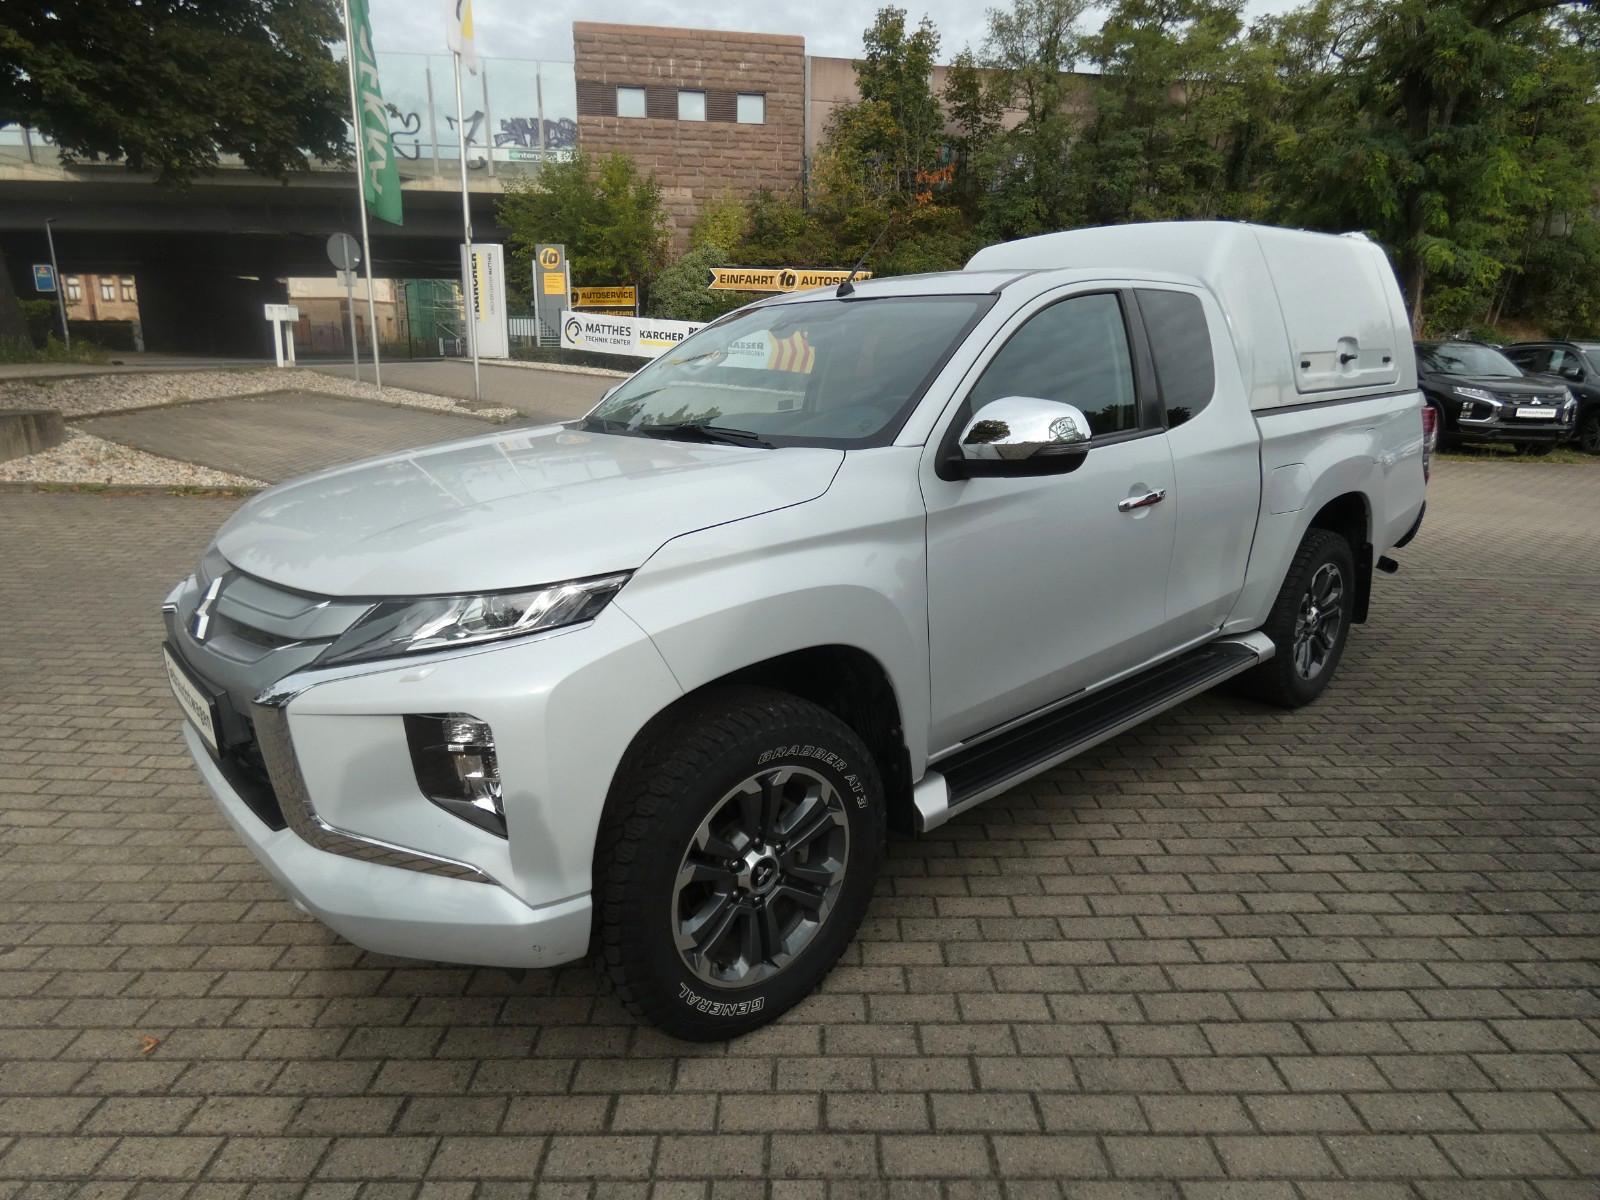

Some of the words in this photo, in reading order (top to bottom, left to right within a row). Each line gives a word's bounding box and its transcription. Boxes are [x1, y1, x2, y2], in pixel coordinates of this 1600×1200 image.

[719, 274, 775, 285] EINFAHRT
[581, 291, 633, 299] AUTOSERVICE
[585, 323, 632, 337] MATTHES
[639, 329, 684, 341] KÄRCHER
[585, 335, 609, 344] TECHNIK
[610, 338, 631, 346] CENTER
[757, 744, 848, 772] GRABBER
[678, 982, 765, 1017] GENERAL
